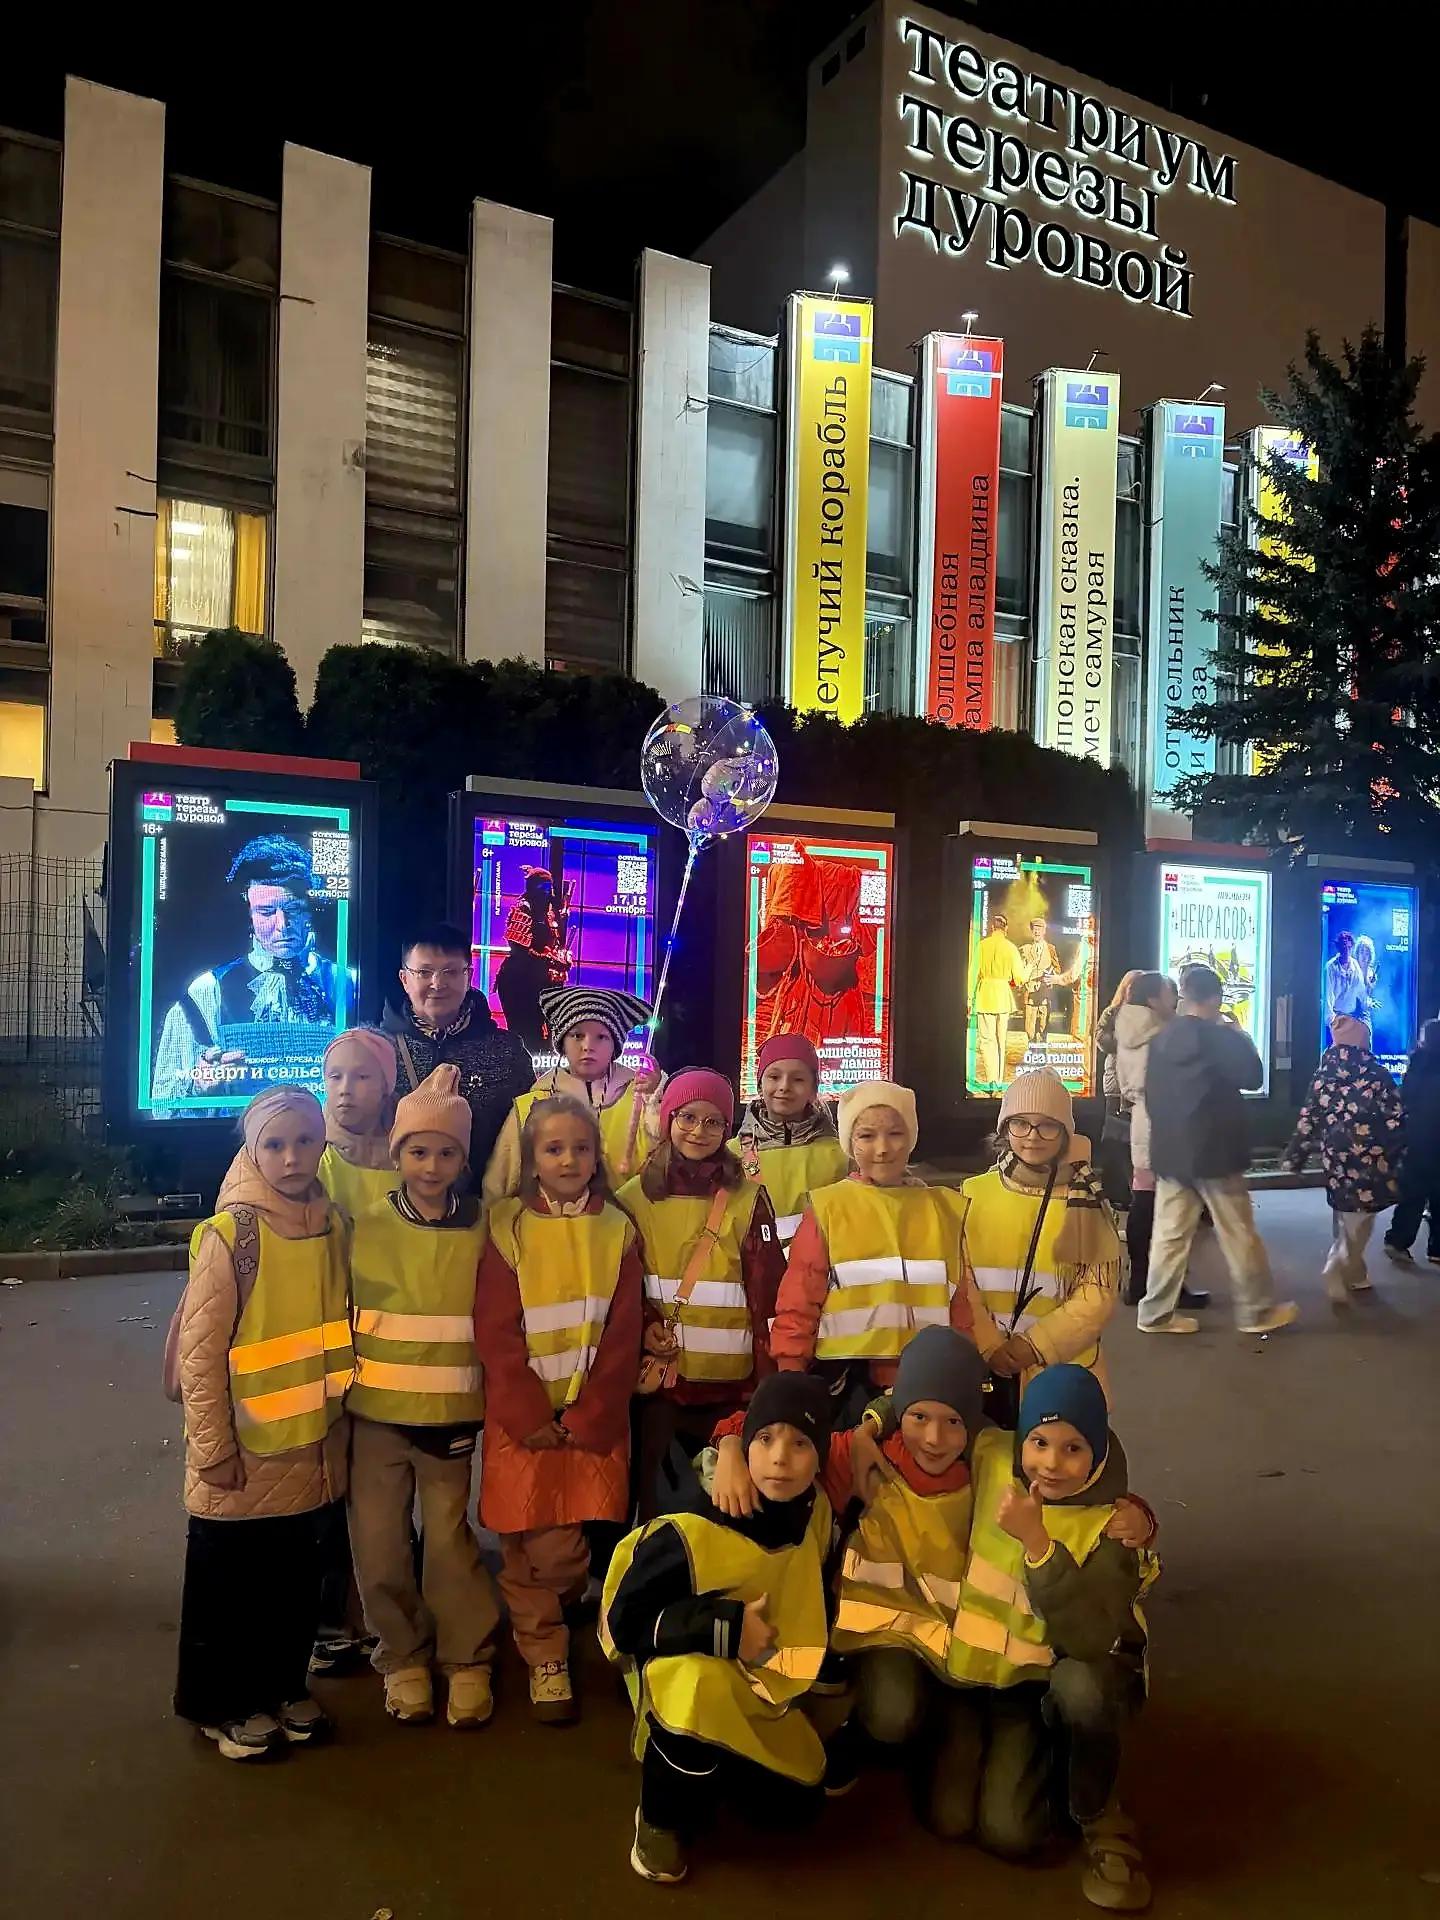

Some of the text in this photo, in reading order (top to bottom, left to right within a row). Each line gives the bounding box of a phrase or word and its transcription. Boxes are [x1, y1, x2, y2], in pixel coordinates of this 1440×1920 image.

[901, 17, 1239, 206] театриум
[900, 94, 1160, 241] терезы
[894, 171, 1195, 319] дуровой
[1060, 476, 1081, 593] сказка.
[811, 375, 851, 717] етучий корабль
[964, 474, 991, 724] ампа аладдина
[933, 553, 959, 723] олшебная
[1083, 551, 1108, 759] меч самурая
[175, 794, 210, 806] театр
[175, 804, 218, 814] терезы
[175, 812, 225, 823] дуровой
[508, 822, 537, 832] театр
[508, 830, 543, 840] терезы
[508, 838, 548, 848] дуровой
[750, 865, 760, 875] 6+
[326, 876, 349, 890] 22
[308, 889, 349, 899] октября
[605, 905, 646, 915] октября
[1180, 903, 1247, 941] НЕКРАСОВ
[817, 1045, 882, 1059] олшебная
[840, 1058, 882, 1069] лампа
[176, 1065, 322, 1082] моцарт и салье
[820, 1069, 882, 1082] аладдина
